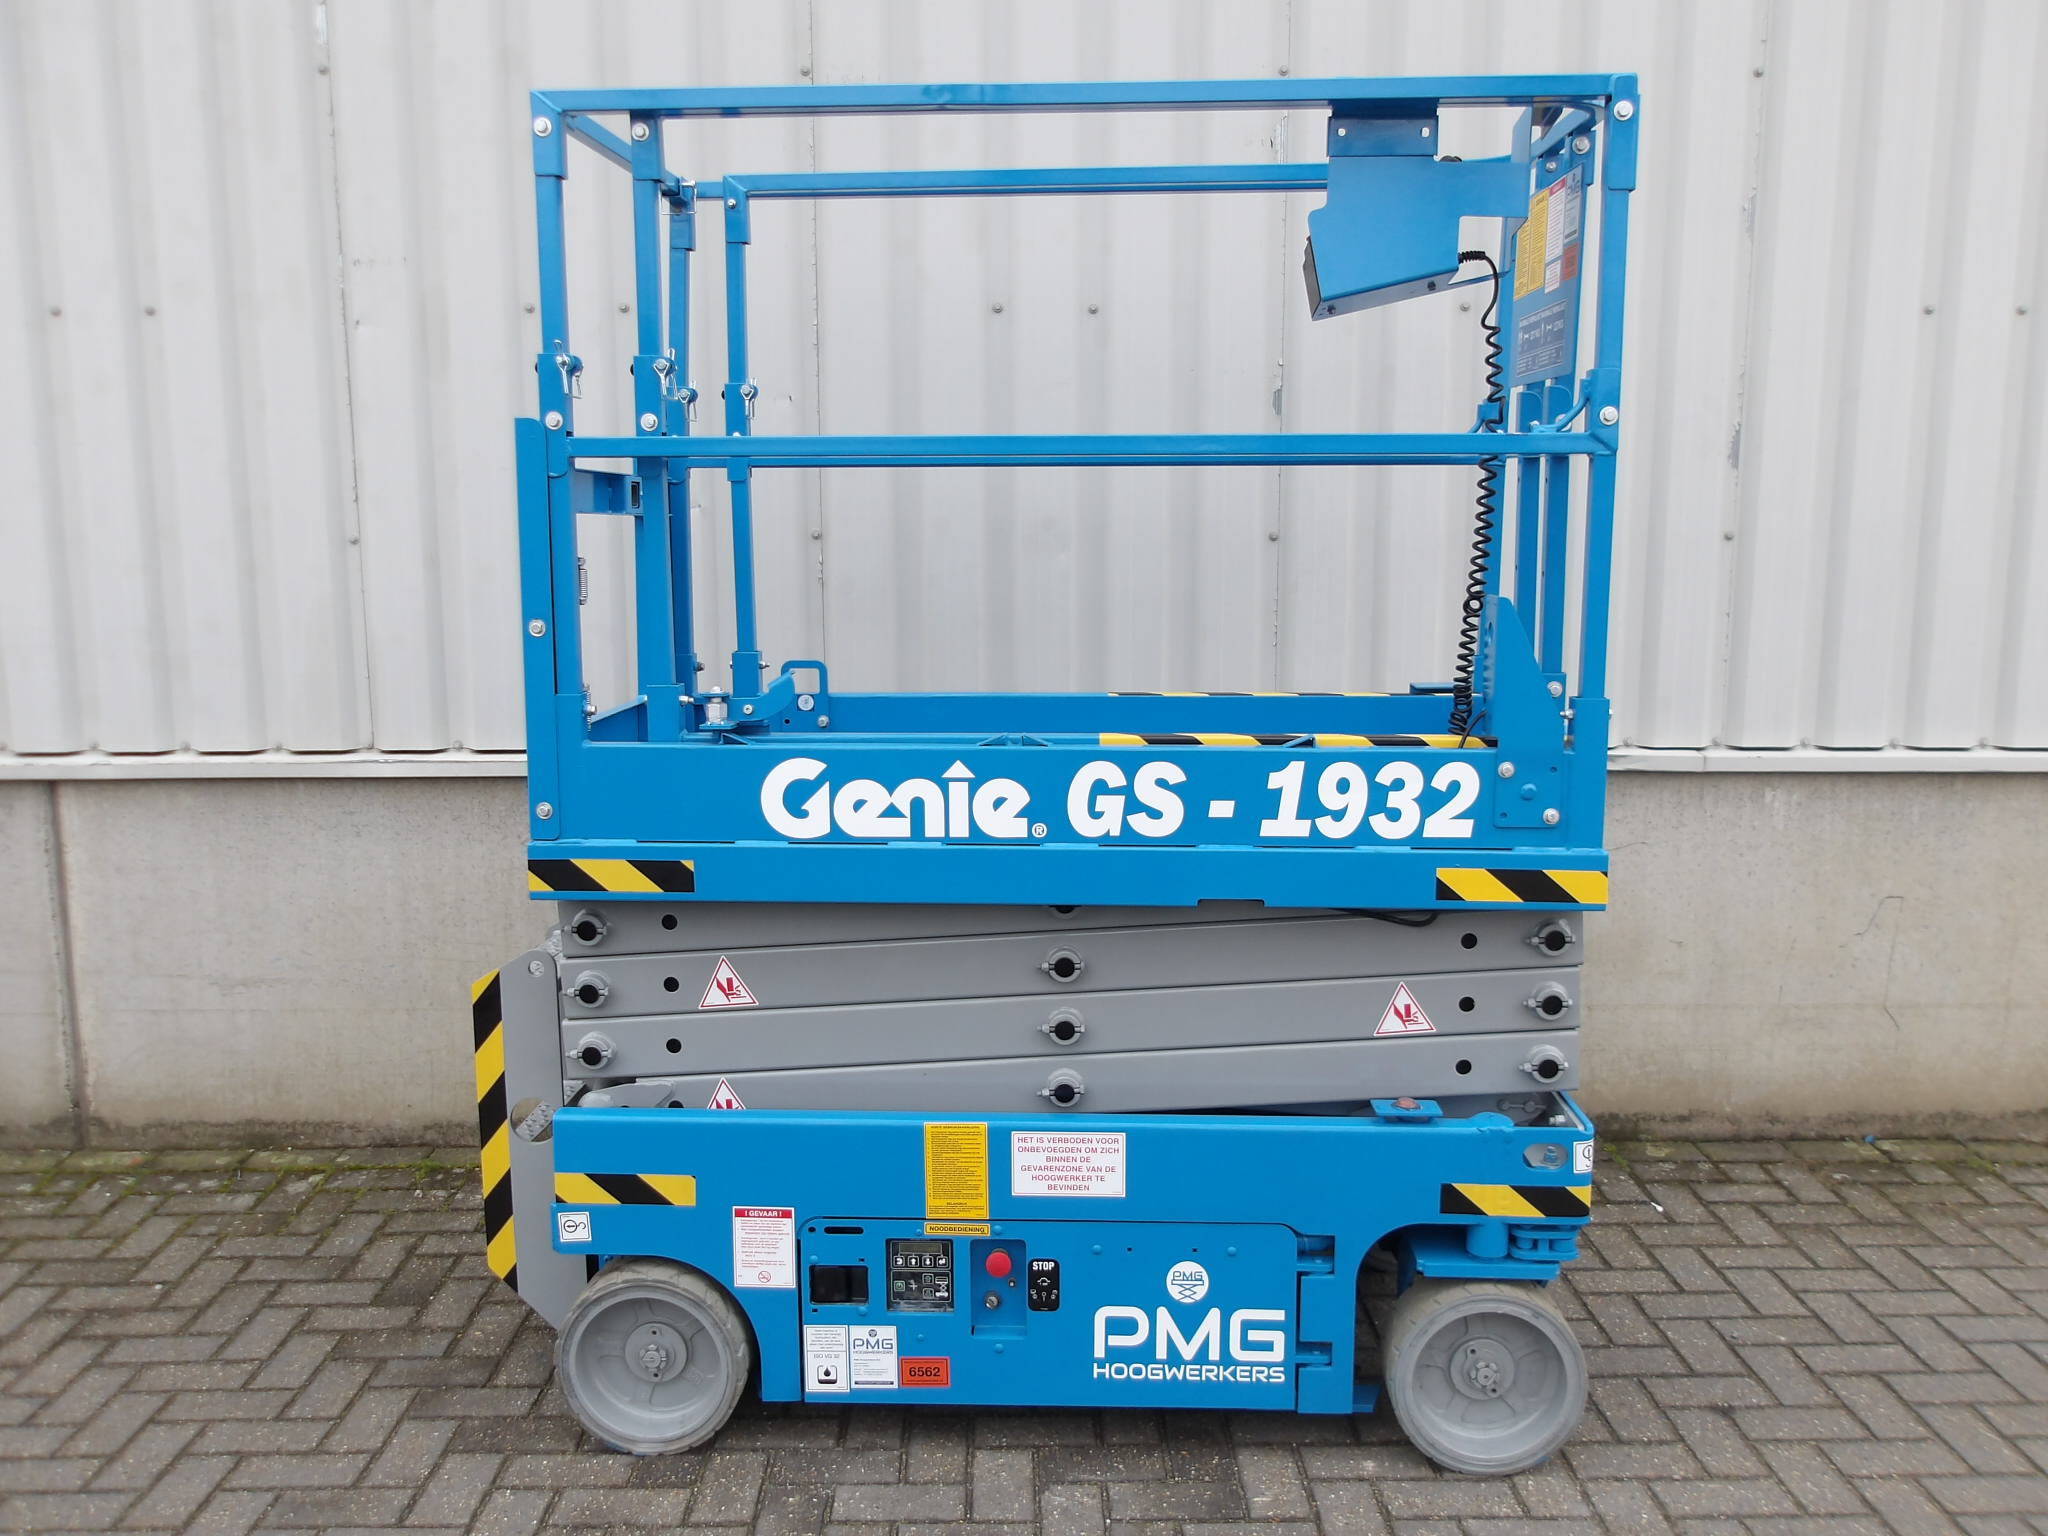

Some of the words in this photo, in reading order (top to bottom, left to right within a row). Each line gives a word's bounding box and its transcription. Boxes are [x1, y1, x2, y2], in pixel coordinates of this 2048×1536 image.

[1067, 759, 1187, 839] GS
[1258, 759, 1481, 840] 1932
[1017, 1136, 1034, 1144] HET
[1036, 1136, 1045, 1144] IS
[1047, 1137, 1093, 1145] VERBODEN
[1095, 1137, 1120, 1145] VOOR
[1017, 1146, 1082, 1154] ONBEVOEGDEN
[1084, 1146, 1098, 1154] OM
[1045, 1155, 1078, 1163] BINNEN
[1020, 1165, 1083, 1173] GEVARENZONE
[1086, 1165, 1102, 1173] VAN
[1105, 1165, 1117, 1173] DE
[1031, 1174, 1093, 1182] HOOGWERKER
[929, 1225, 985, 1233] NOODBEDIENING
[1032, 1261, 1055, 1271] STOP
[1172, 1270, 1203, 1281] PMG
[1094, 1305, 1286, 1362] PMG
[853, 1338, 894, 1350] PMG
[909, 1366, 941, 1378] 6562
[1092, 1362, 1286, 1383] HOOGWERKERS
